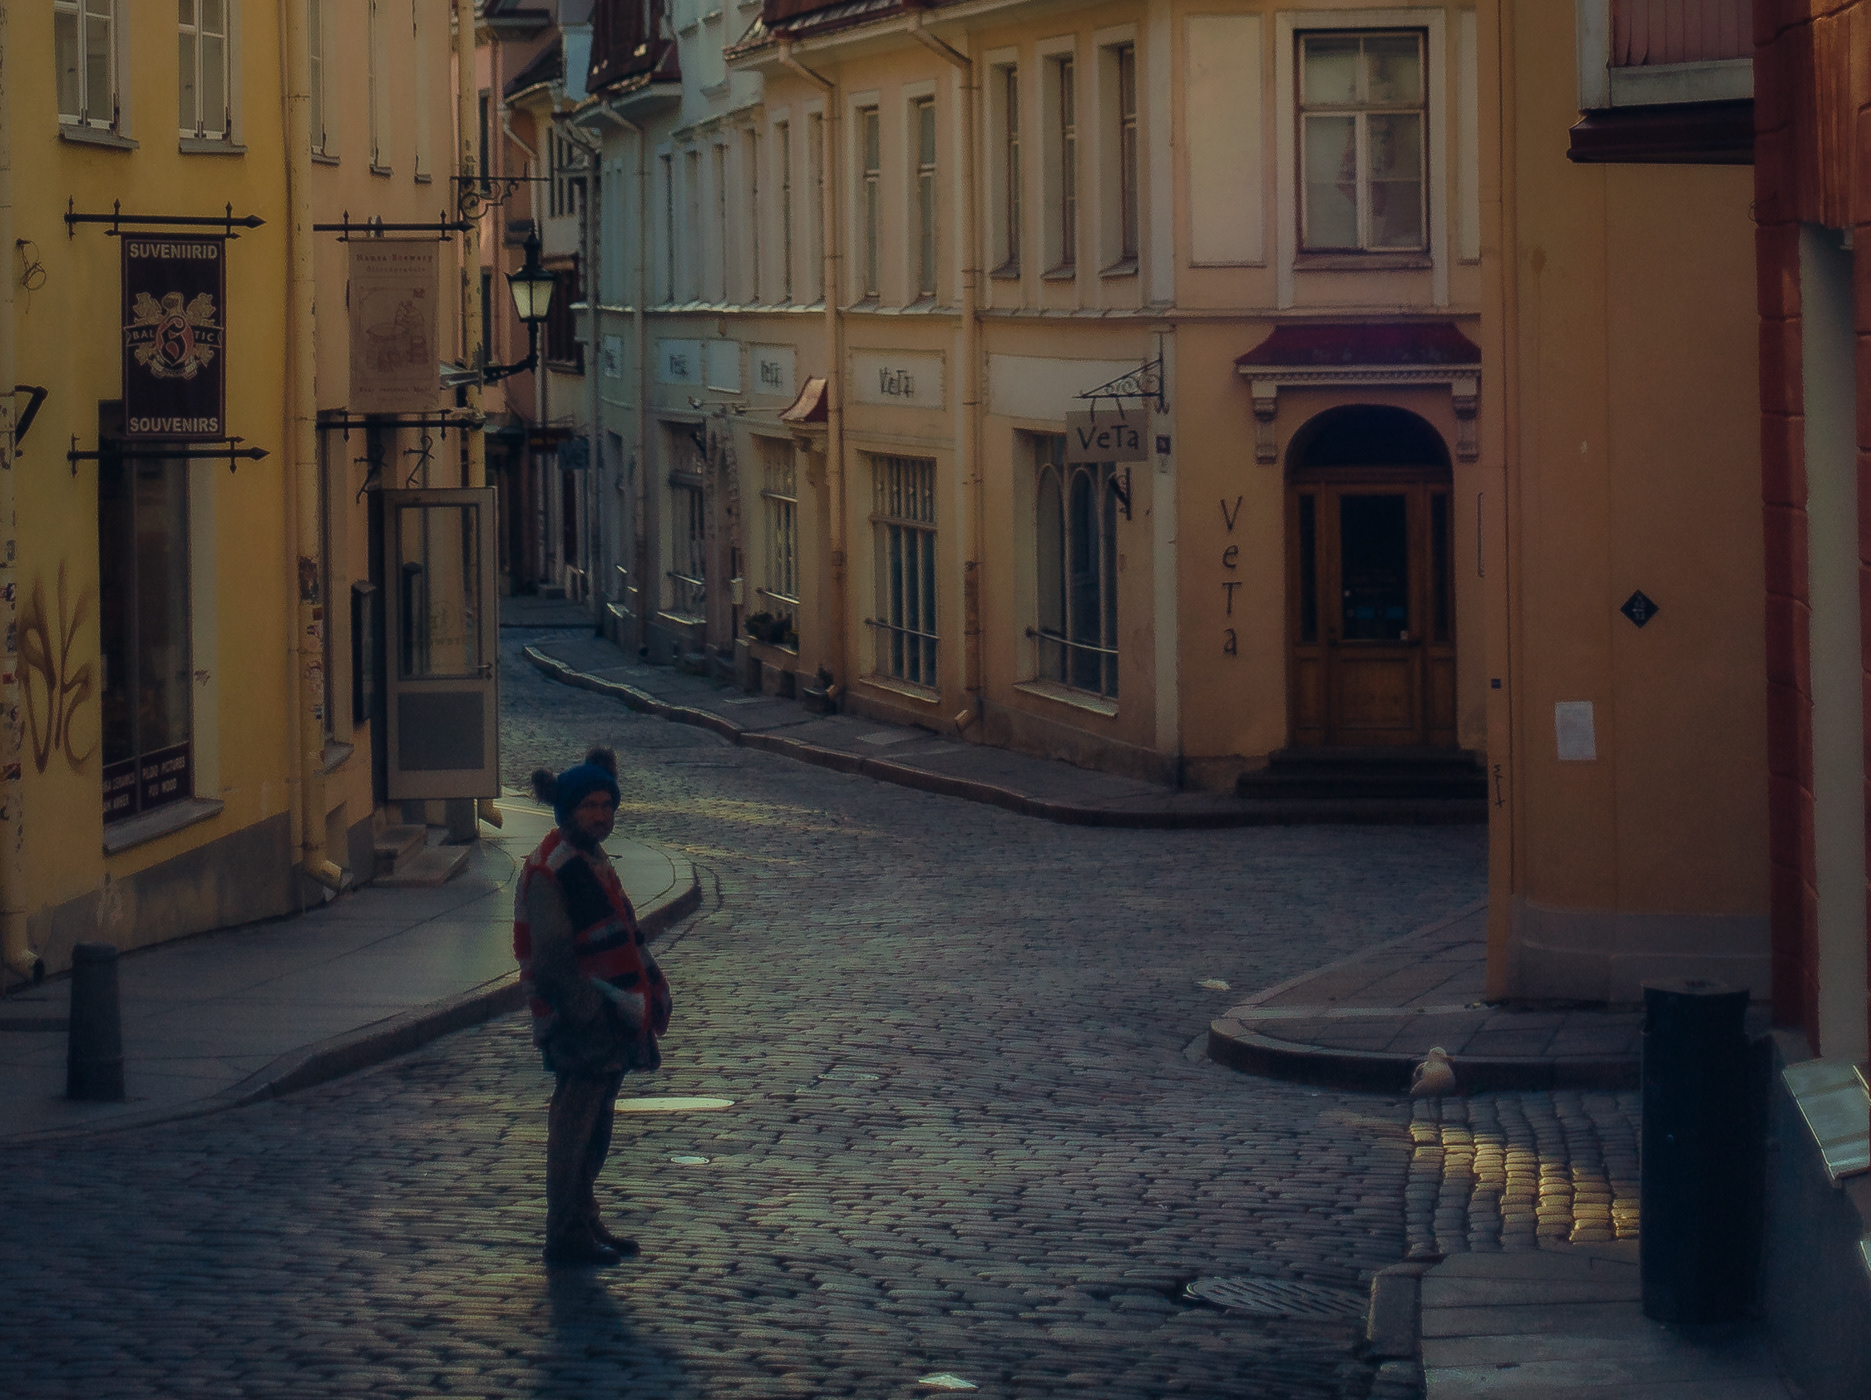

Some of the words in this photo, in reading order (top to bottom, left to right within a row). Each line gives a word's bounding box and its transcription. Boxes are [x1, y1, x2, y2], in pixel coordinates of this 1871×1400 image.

[129, 243, 218, 259] SUVENIIRID
[391, 253, 433, 264] Brewery
[129, 417, 218, 432] SOUVENIRS
[1077, 424, 1139, 450] VeTa
